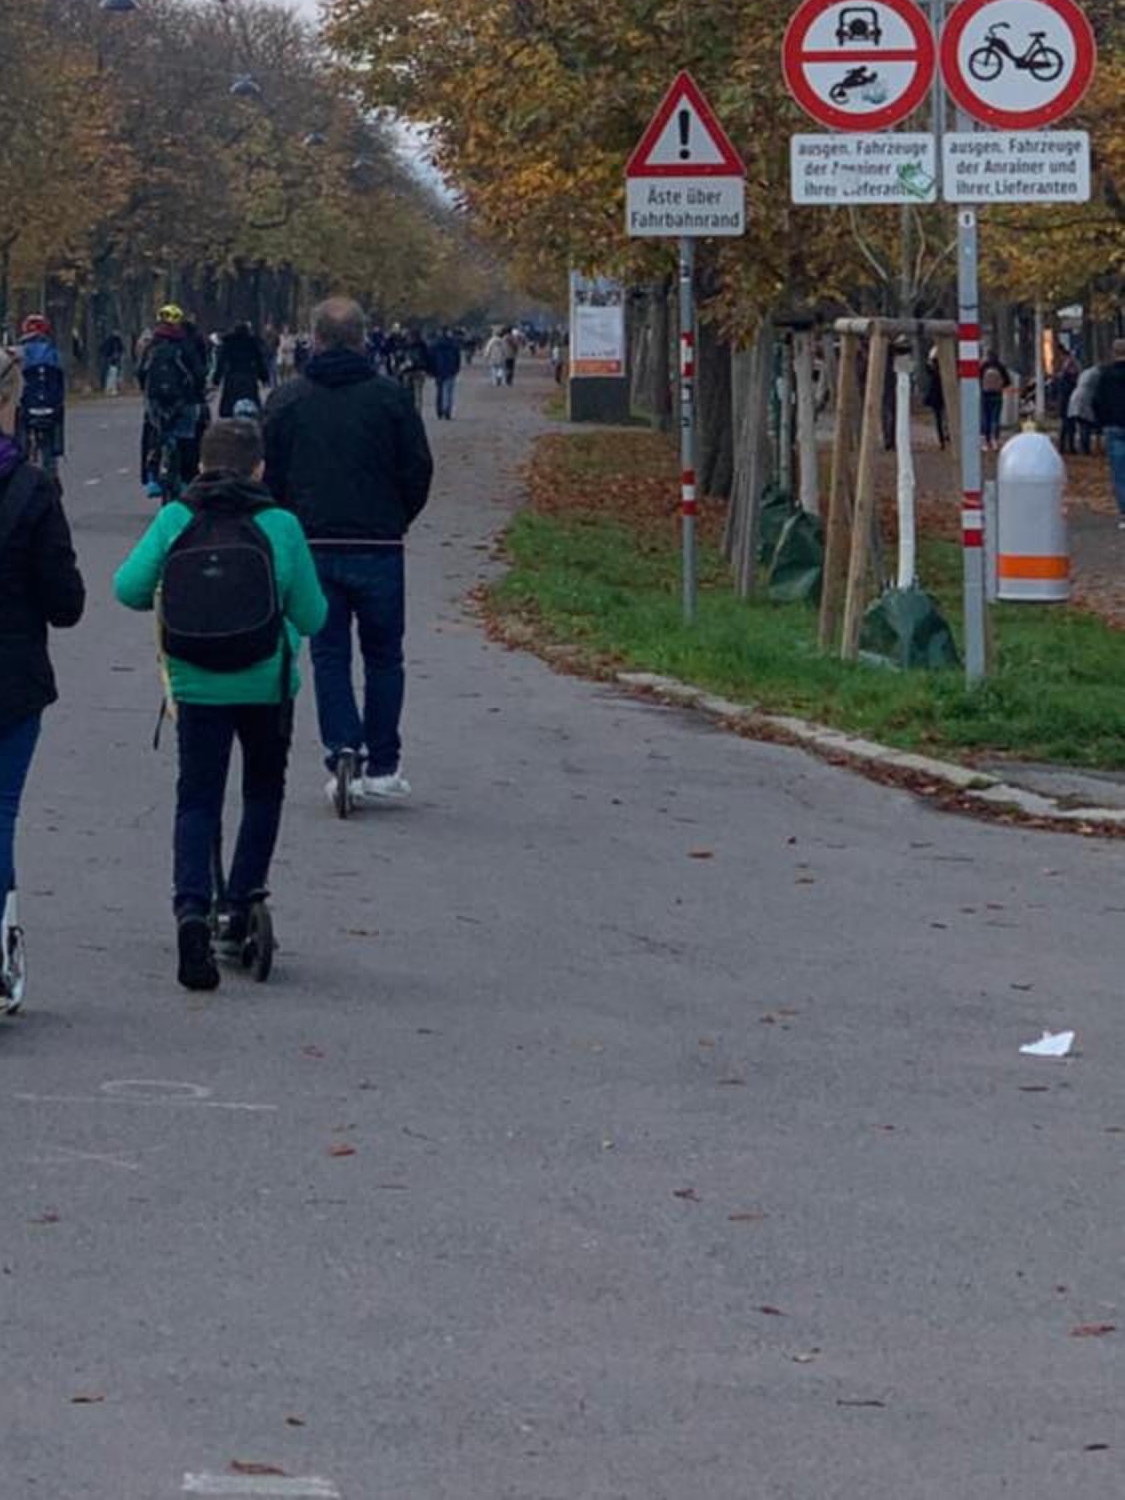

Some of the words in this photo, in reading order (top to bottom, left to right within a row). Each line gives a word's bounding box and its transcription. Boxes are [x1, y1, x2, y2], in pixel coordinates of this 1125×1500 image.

[855, 140, 928, 158] Fahrzeuge
[949, 141, 1005, 157] ausgen.
[1008, 138, 1082, 157] Fahrzeuge
[804, 161, 827, 176] der
[956, 159, 980, 175] der
[984, 158, 1045, 174] Anrainer
[1049, 159, 1077, 174] und
[647, 184, 682, 205] Äste
[686, 187, 722, 205] über
[804, 180, 837, 197] ihrer
[995, 180, 1078, 196] Lieferanten
[631, 211, 740, 229] Fahrbahnrand
